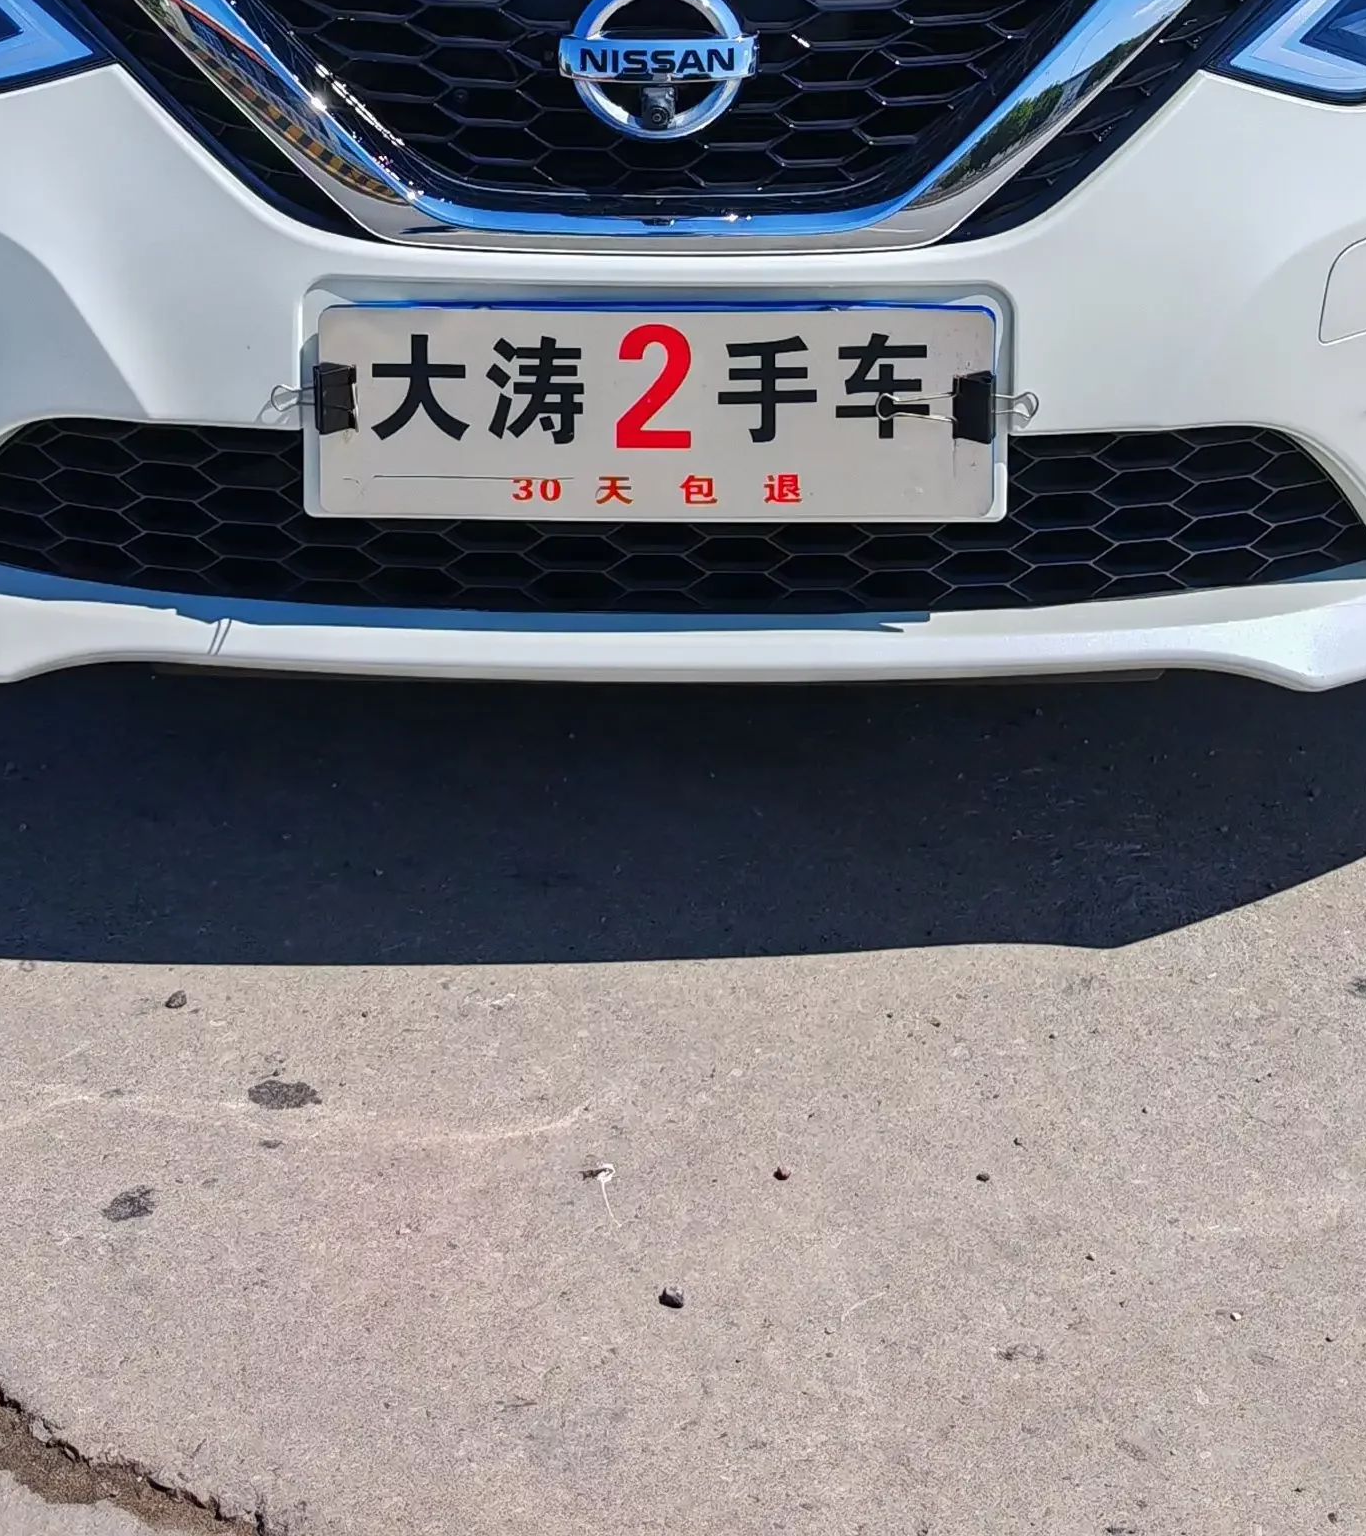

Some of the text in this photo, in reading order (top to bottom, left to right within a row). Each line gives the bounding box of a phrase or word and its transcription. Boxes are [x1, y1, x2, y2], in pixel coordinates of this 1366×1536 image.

[579, 46, 736, 75] NISSAN
[370, 322, 932, 450] 大涛2手车
